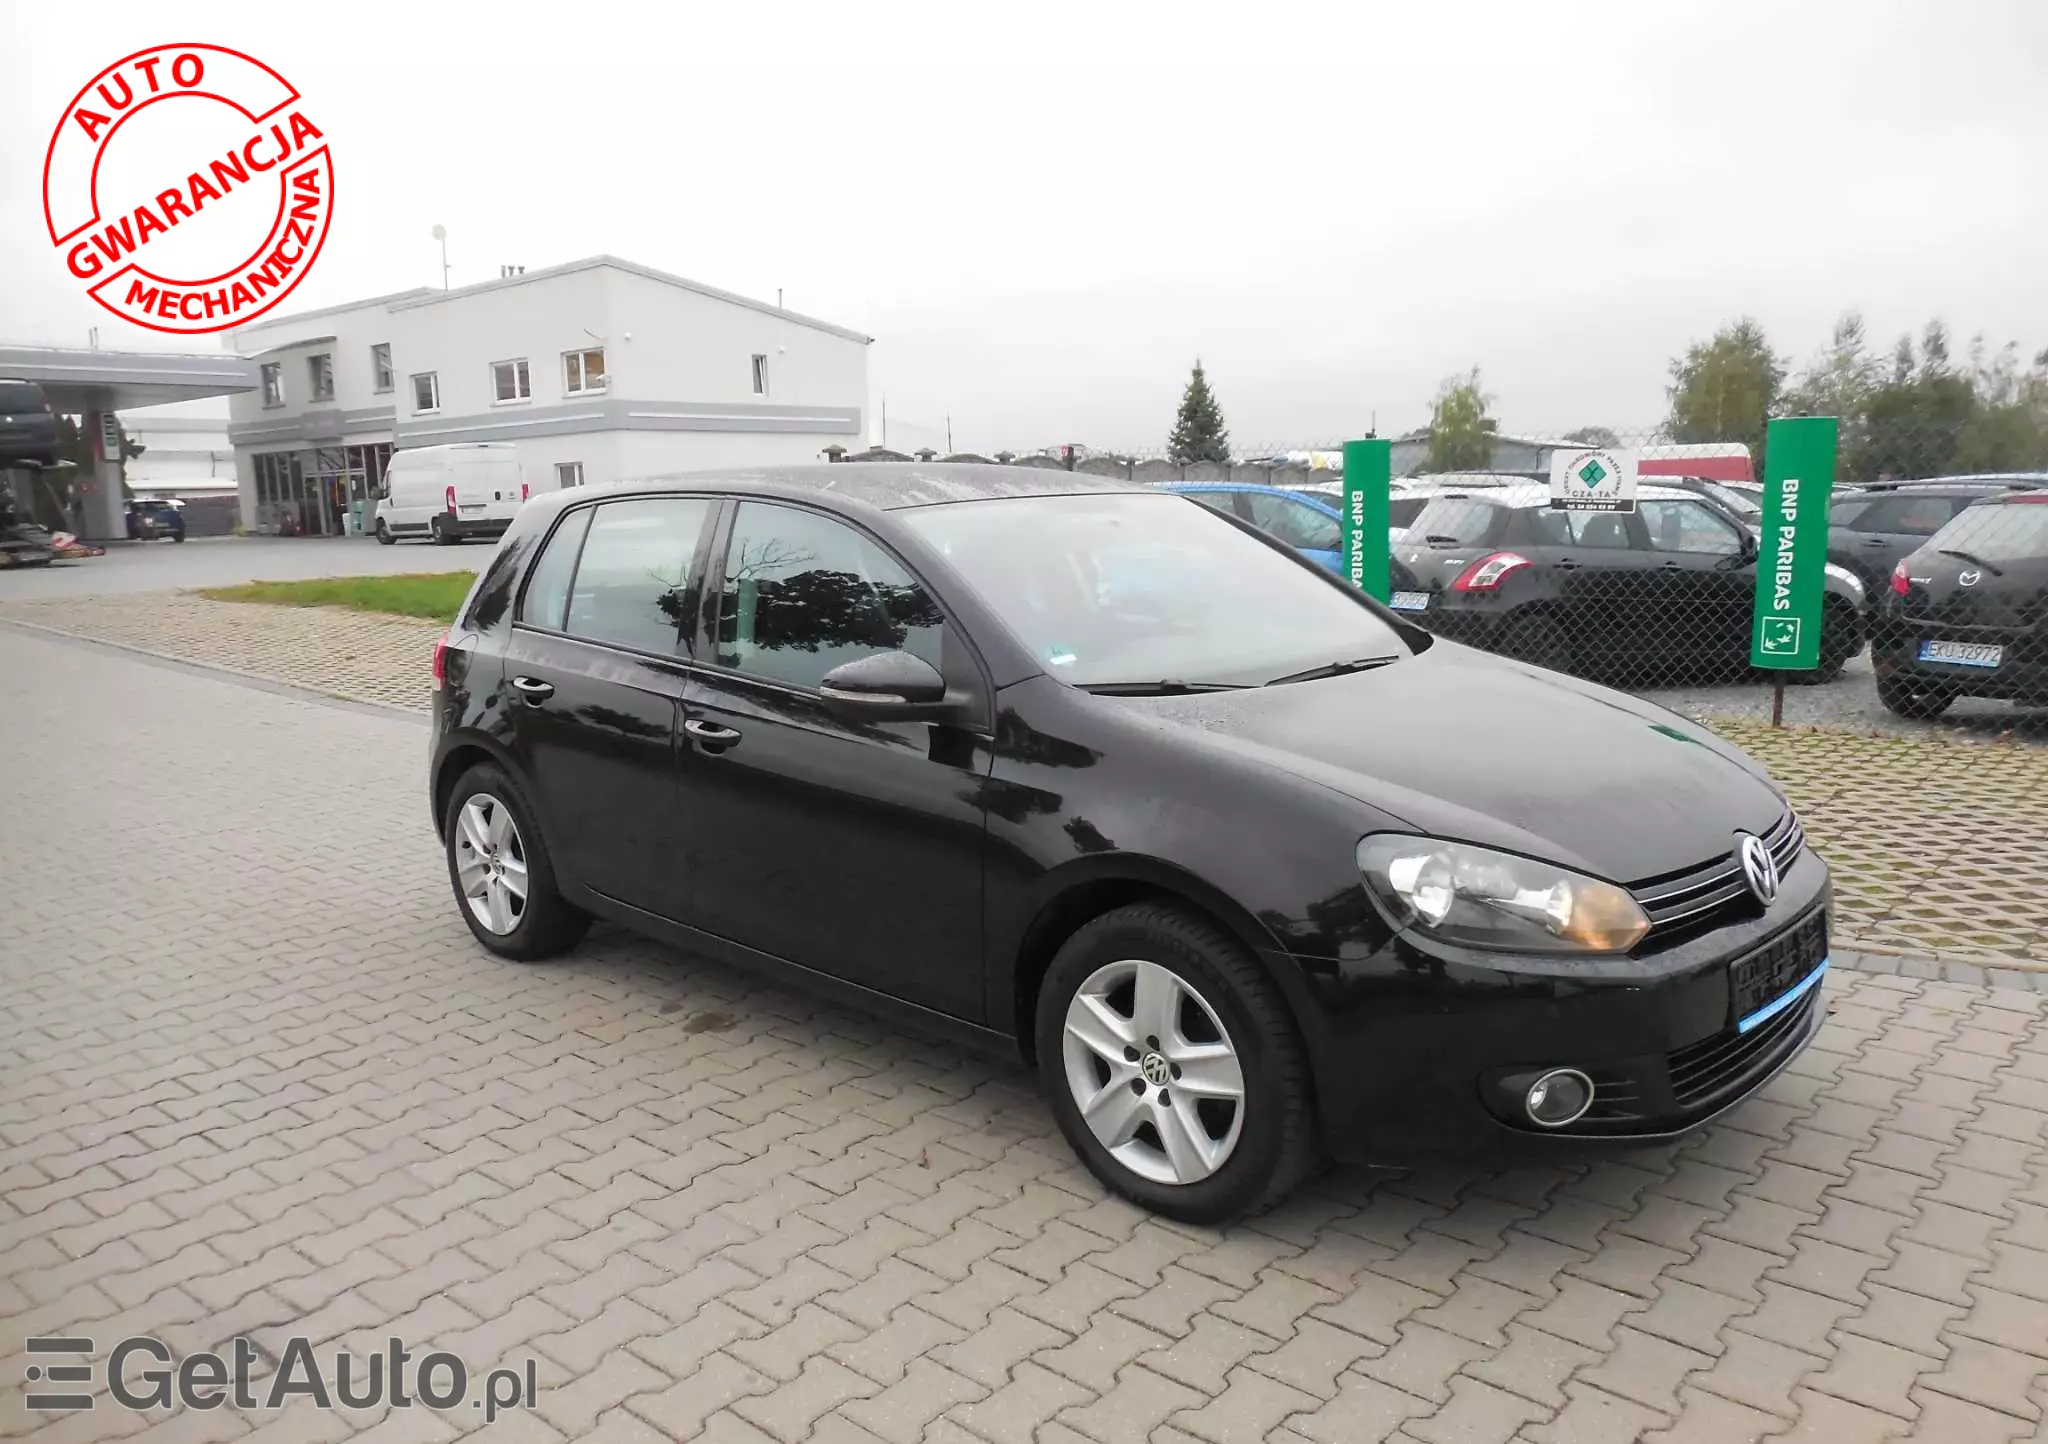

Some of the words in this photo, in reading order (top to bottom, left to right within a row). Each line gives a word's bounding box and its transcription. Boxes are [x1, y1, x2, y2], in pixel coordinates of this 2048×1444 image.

[1351, 490, 1364, 525] BNP
[1780, 479, 1799, 522] BNP
[1351, 529, 1364, 588] PARIBA
[1773, 526, 1796, 610] PARIBAS
